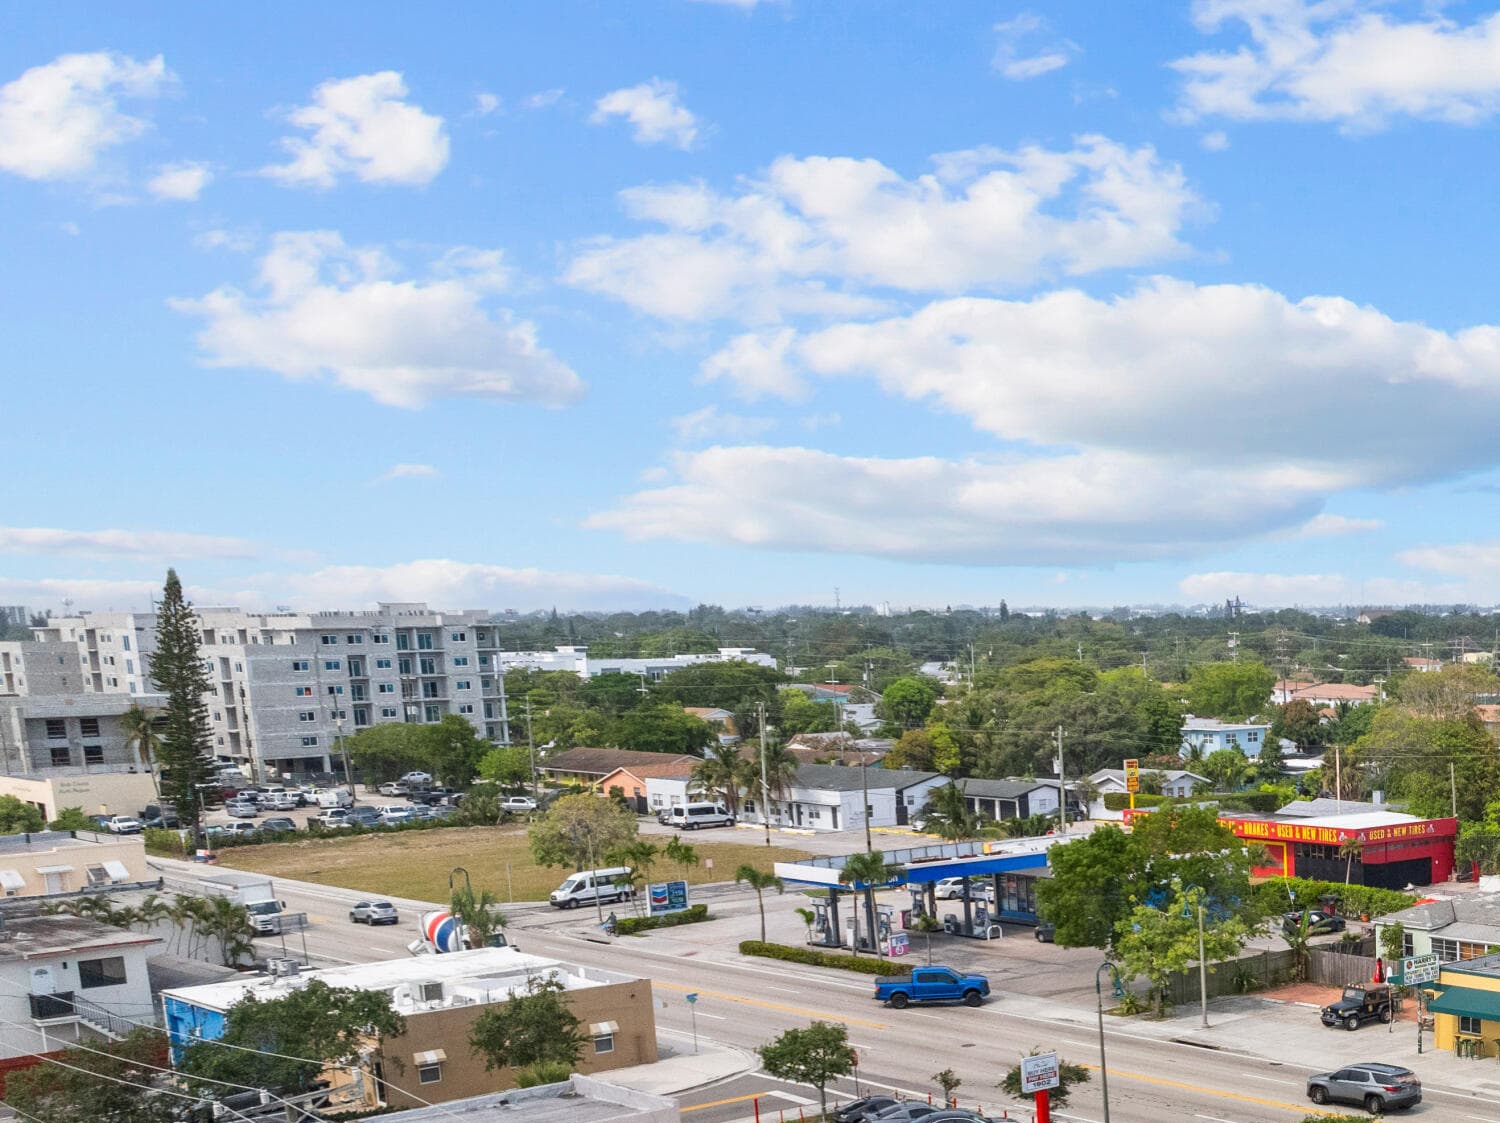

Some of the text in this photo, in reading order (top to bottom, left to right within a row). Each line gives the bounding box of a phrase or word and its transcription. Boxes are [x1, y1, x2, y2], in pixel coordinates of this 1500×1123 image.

[1244, 822, 1269, 836] BRAKES
[1277, 825, 1293, 838] USED
[1302, 827, 1316, 841] NEW
[1318, 828, 1337, 842] TIRES
[1369, 829, 1385, 840] USED
[1393, 826, 1407, 837] NEW
[1408, 824, 1426, 835] TIRES
